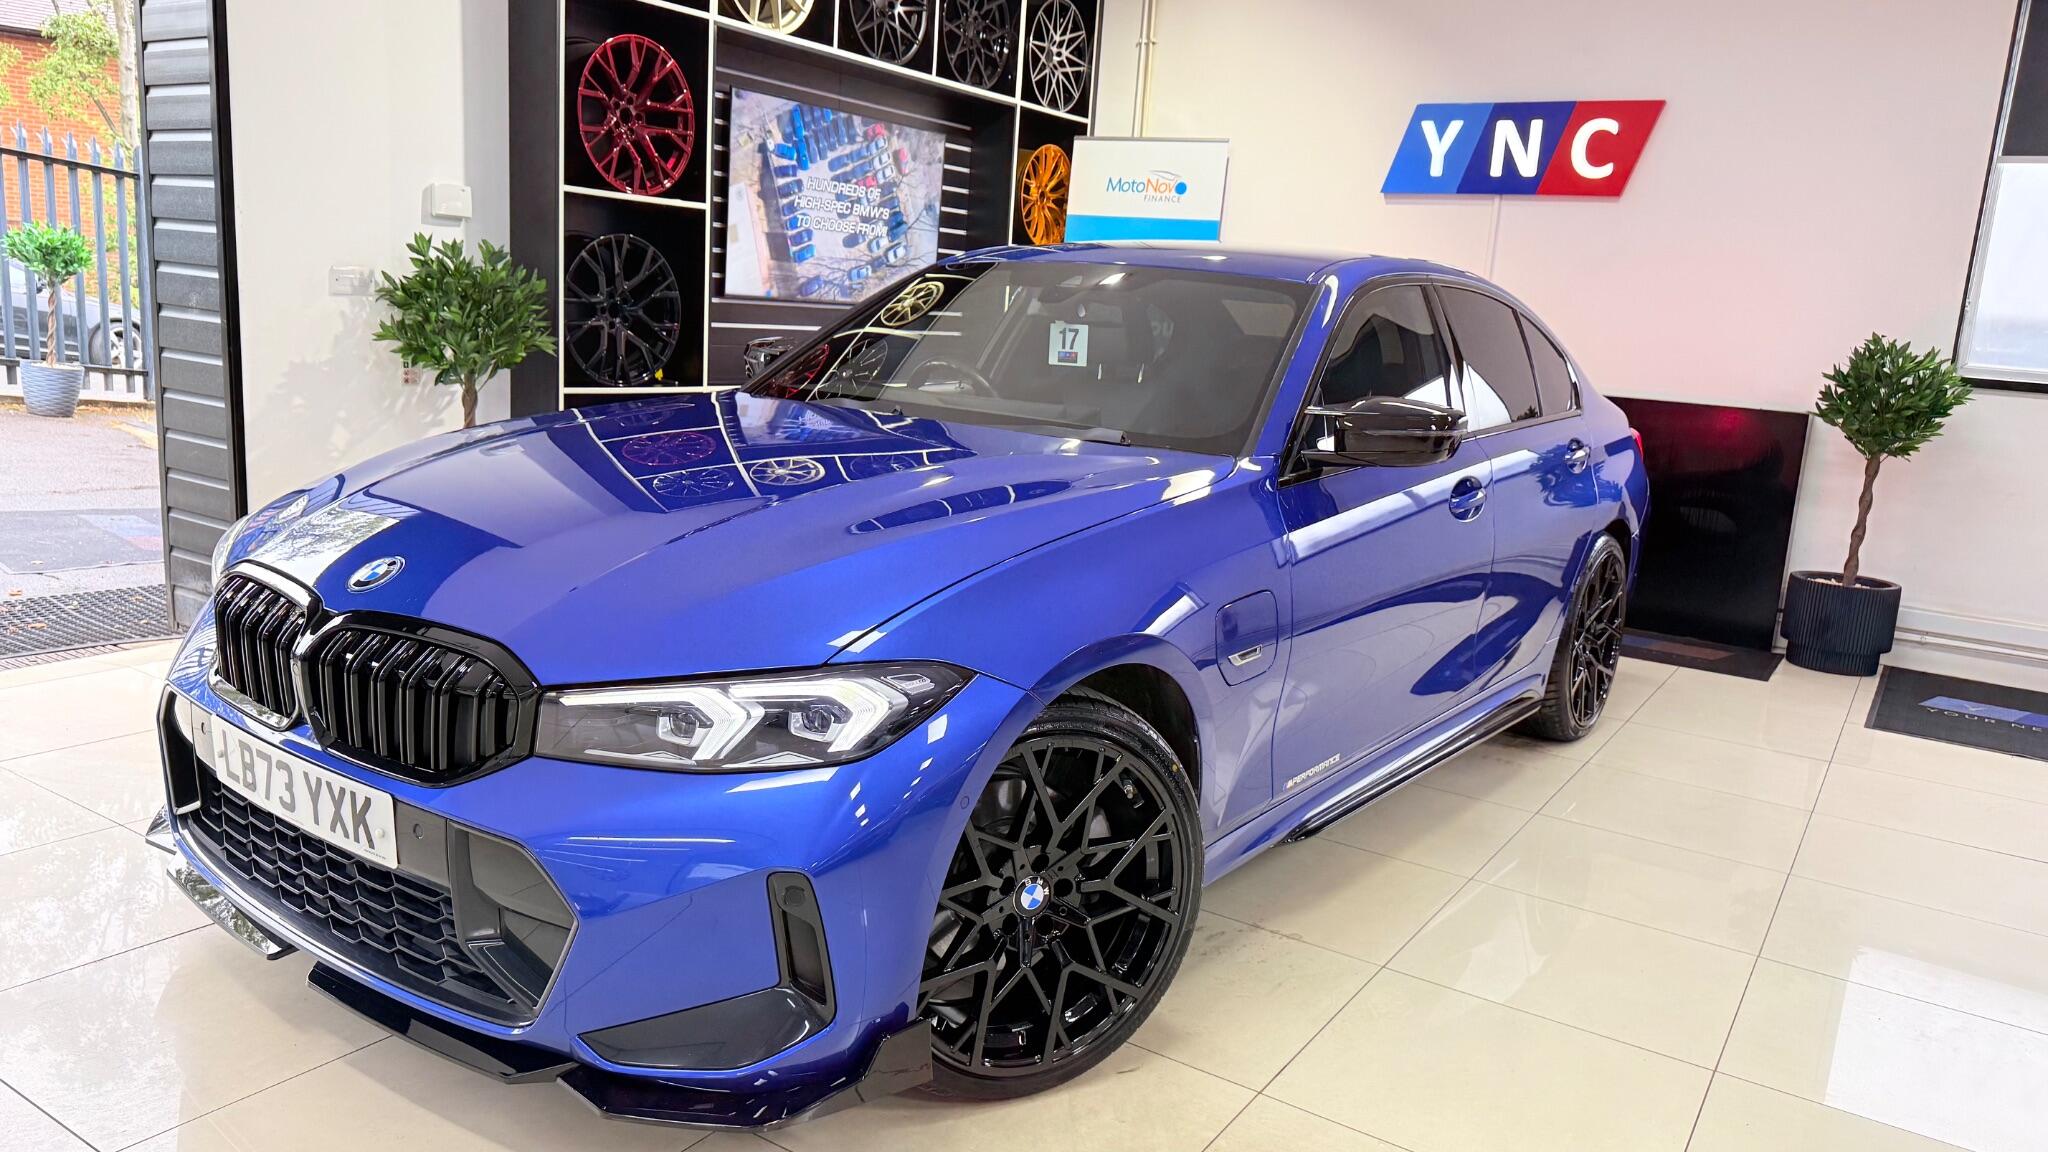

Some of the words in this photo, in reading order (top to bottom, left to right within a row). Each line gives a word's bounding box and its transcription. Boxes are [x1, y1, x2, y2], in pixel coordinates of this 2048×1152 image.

[1420, 117, 1619, 179] YNC
[807, 176, 866, 197] HUNDREDS
[867, 187, 882, 200] OF
[1143, 195, 1182, 204] FINANCE
[794, 195, 851, 214] HIGH-SPEC
[852, 203, 890, 220] BMW'S
[796, 214, 811, 228] TO
[813, 217, 857, 234] CHOOSE
[1059, 327, 1080, 350] 17
[222, 729, 297, 814] LB73
[302, 770, 375, 850] YXK
[1024, 876, 1050, 895] BMW
